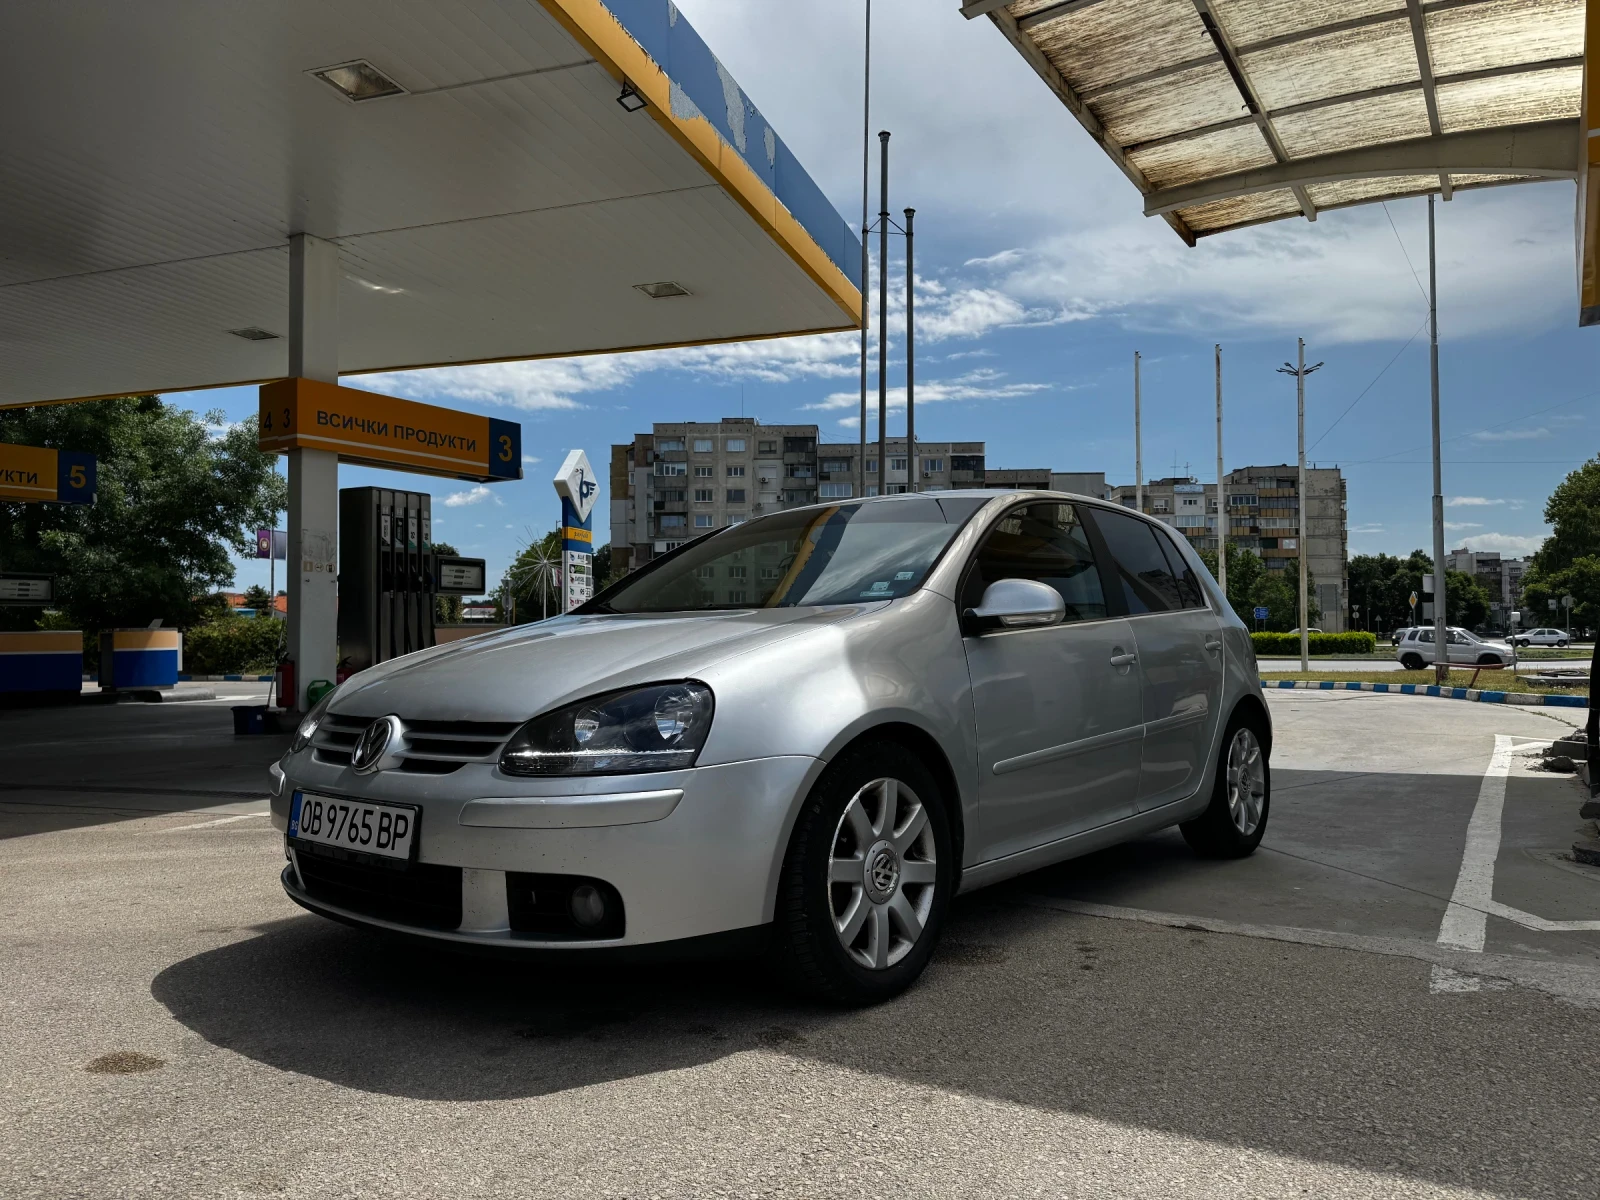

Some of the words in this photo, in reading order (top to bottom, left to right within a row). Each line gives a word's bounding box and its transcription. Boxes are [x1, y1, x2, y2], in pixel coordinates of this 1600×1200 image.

[264, 411, 272, 432] 4
[283, 408, 291, 429] 3
[317, 410, 388, 437] ВСИЧКИ
[393, 425, 476, 452] ПРОДУКТИ
[498, 435, 513, 462] 3
[69, 465, 87, 489] 5
[326, 804, 374, 845] 9765
